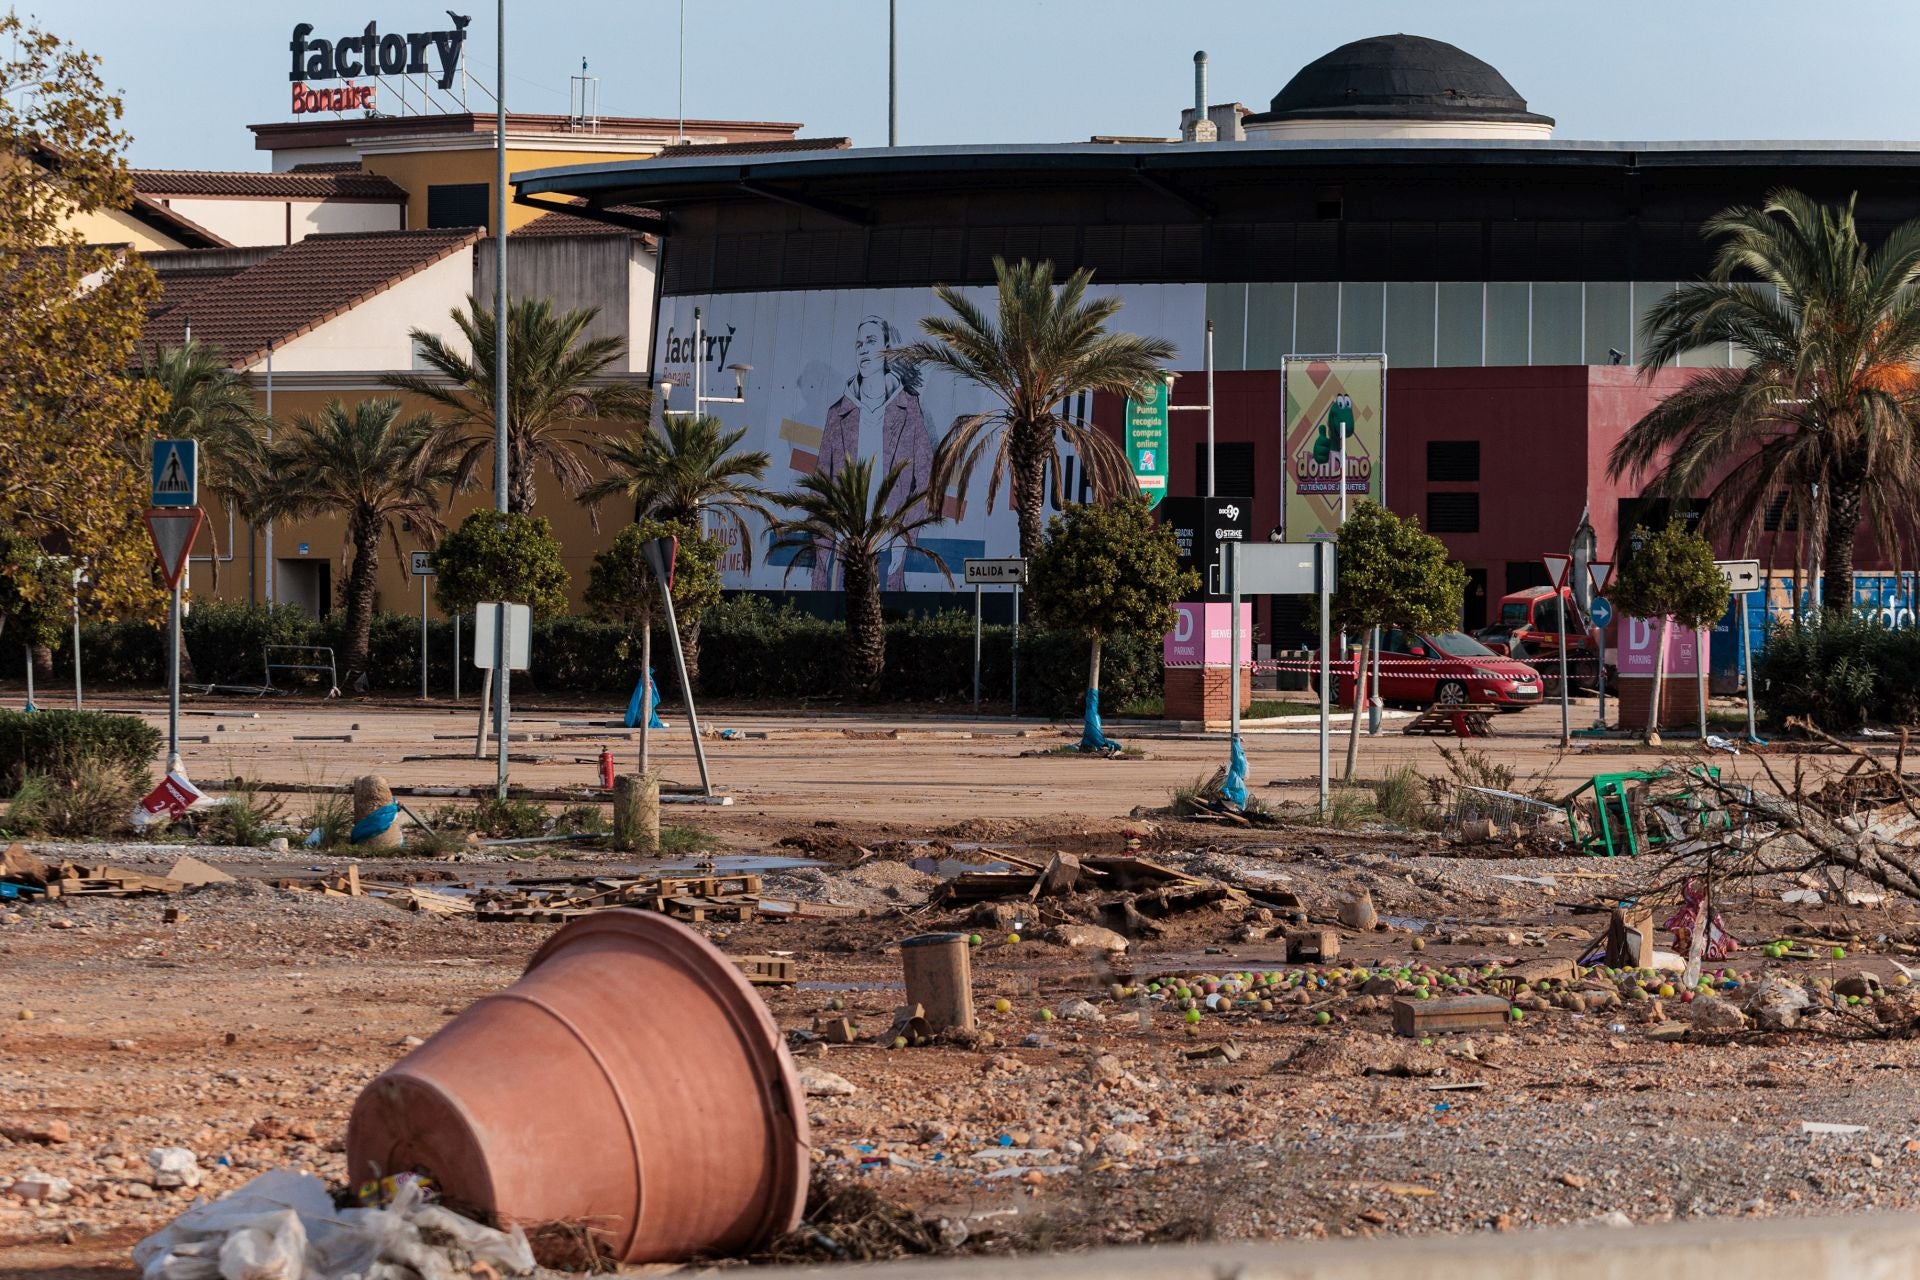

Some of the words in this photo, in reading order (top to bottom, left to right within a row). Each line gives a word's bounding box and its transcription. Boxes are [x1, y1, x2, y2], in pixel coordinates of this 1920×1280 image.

[289, 20, 467, 89] factory
[292, 80, 376, 114] Bonaire
[1136, 406, 1158, 414] Punto
[1132, 418, 1162, 428] recogida
[1132, 429, 1162, 438] compras
[1136, 440, 1159, 448] online
[969, 566, 1004, 576] SALIDA
[1175, 608, 1194, 641] D
[1629, 615, 1650, 650] D
[1174, 646, 1195, 656] PARKING
[1629, 655, 1651, 665] PARKING
